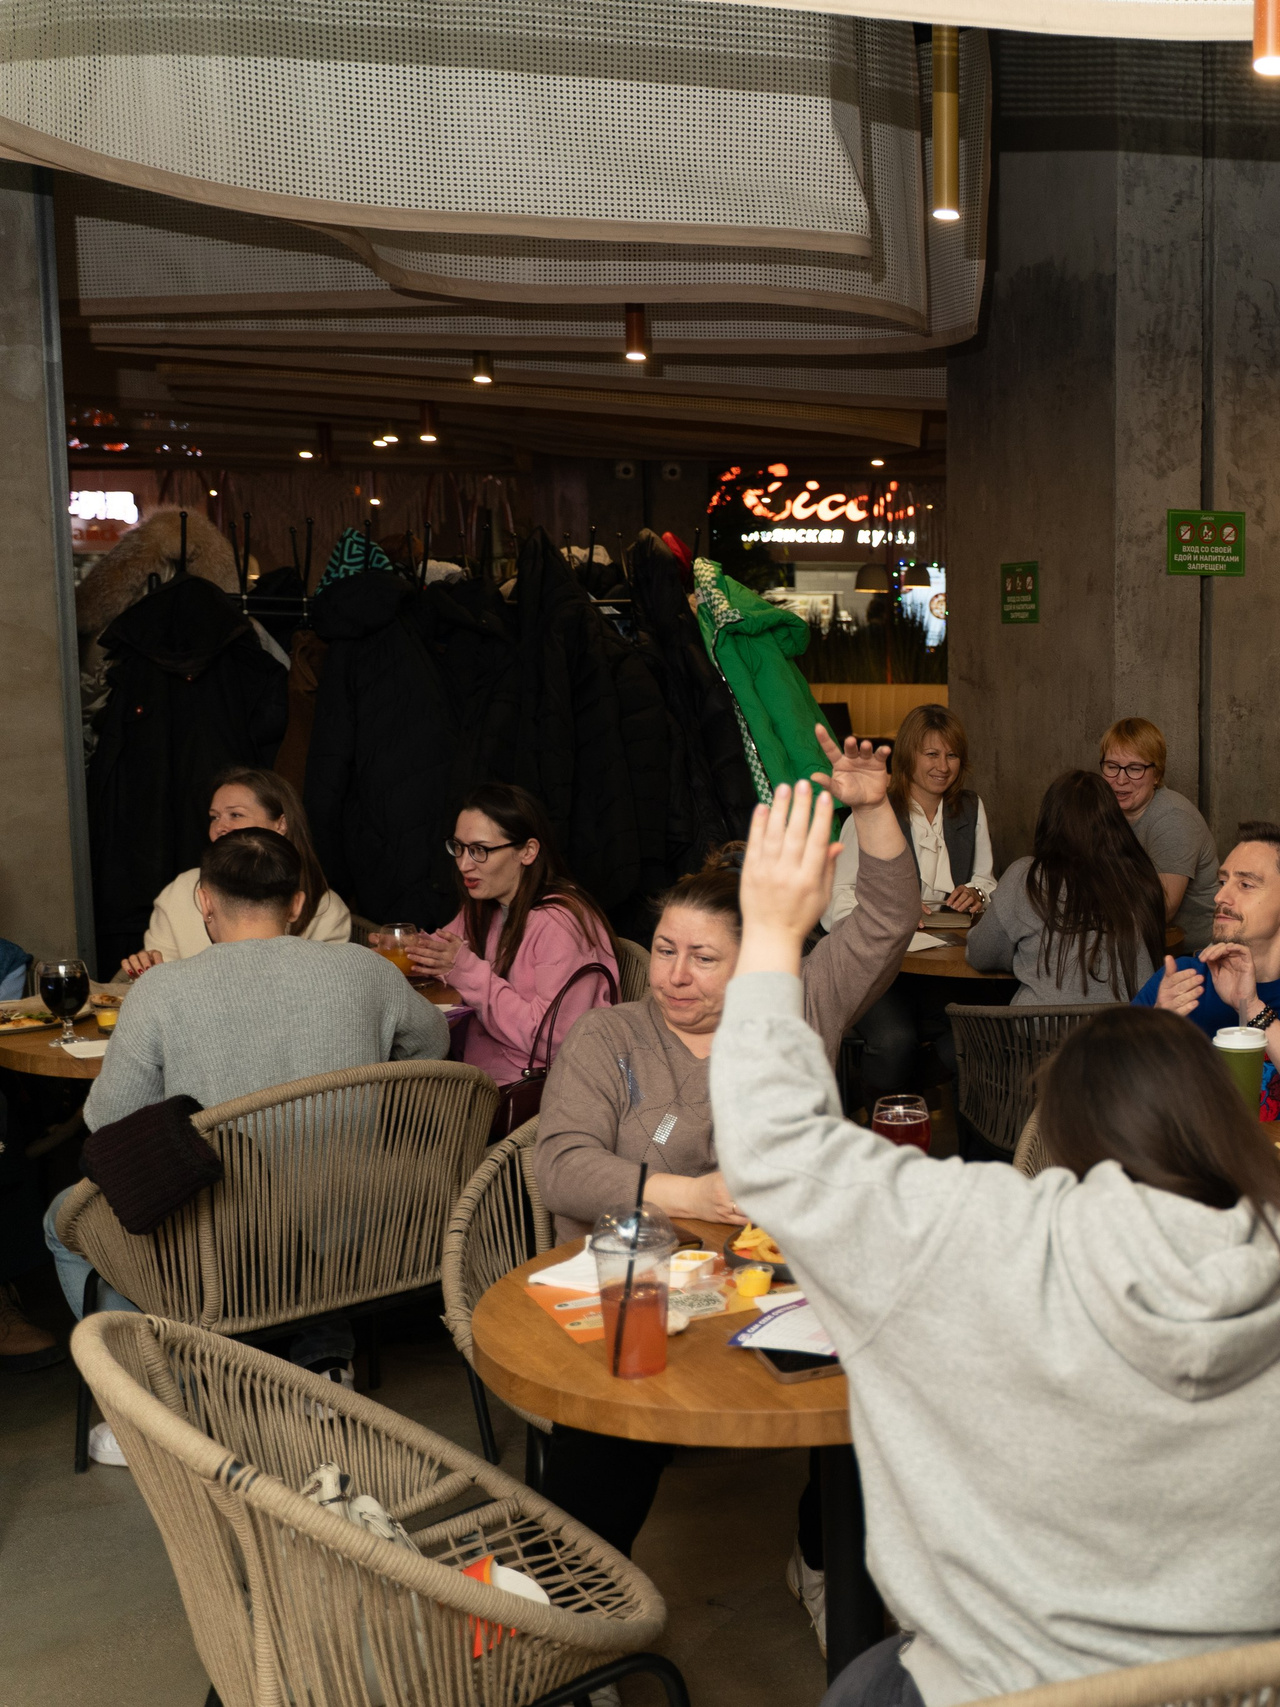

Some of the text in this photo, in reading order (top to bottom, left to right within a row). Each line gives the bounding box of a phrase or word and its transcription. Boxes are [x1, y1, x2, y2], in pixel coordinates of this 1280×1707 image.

[1182, 545, 1199, 554] ВХОД
[1210, 545, 1232, 554] СВОЕЙ
[1174, 553, 1192, 562] ЕДОЙ
[1187, 563, 1227, 571] ЗАПРЕЩЕН!
